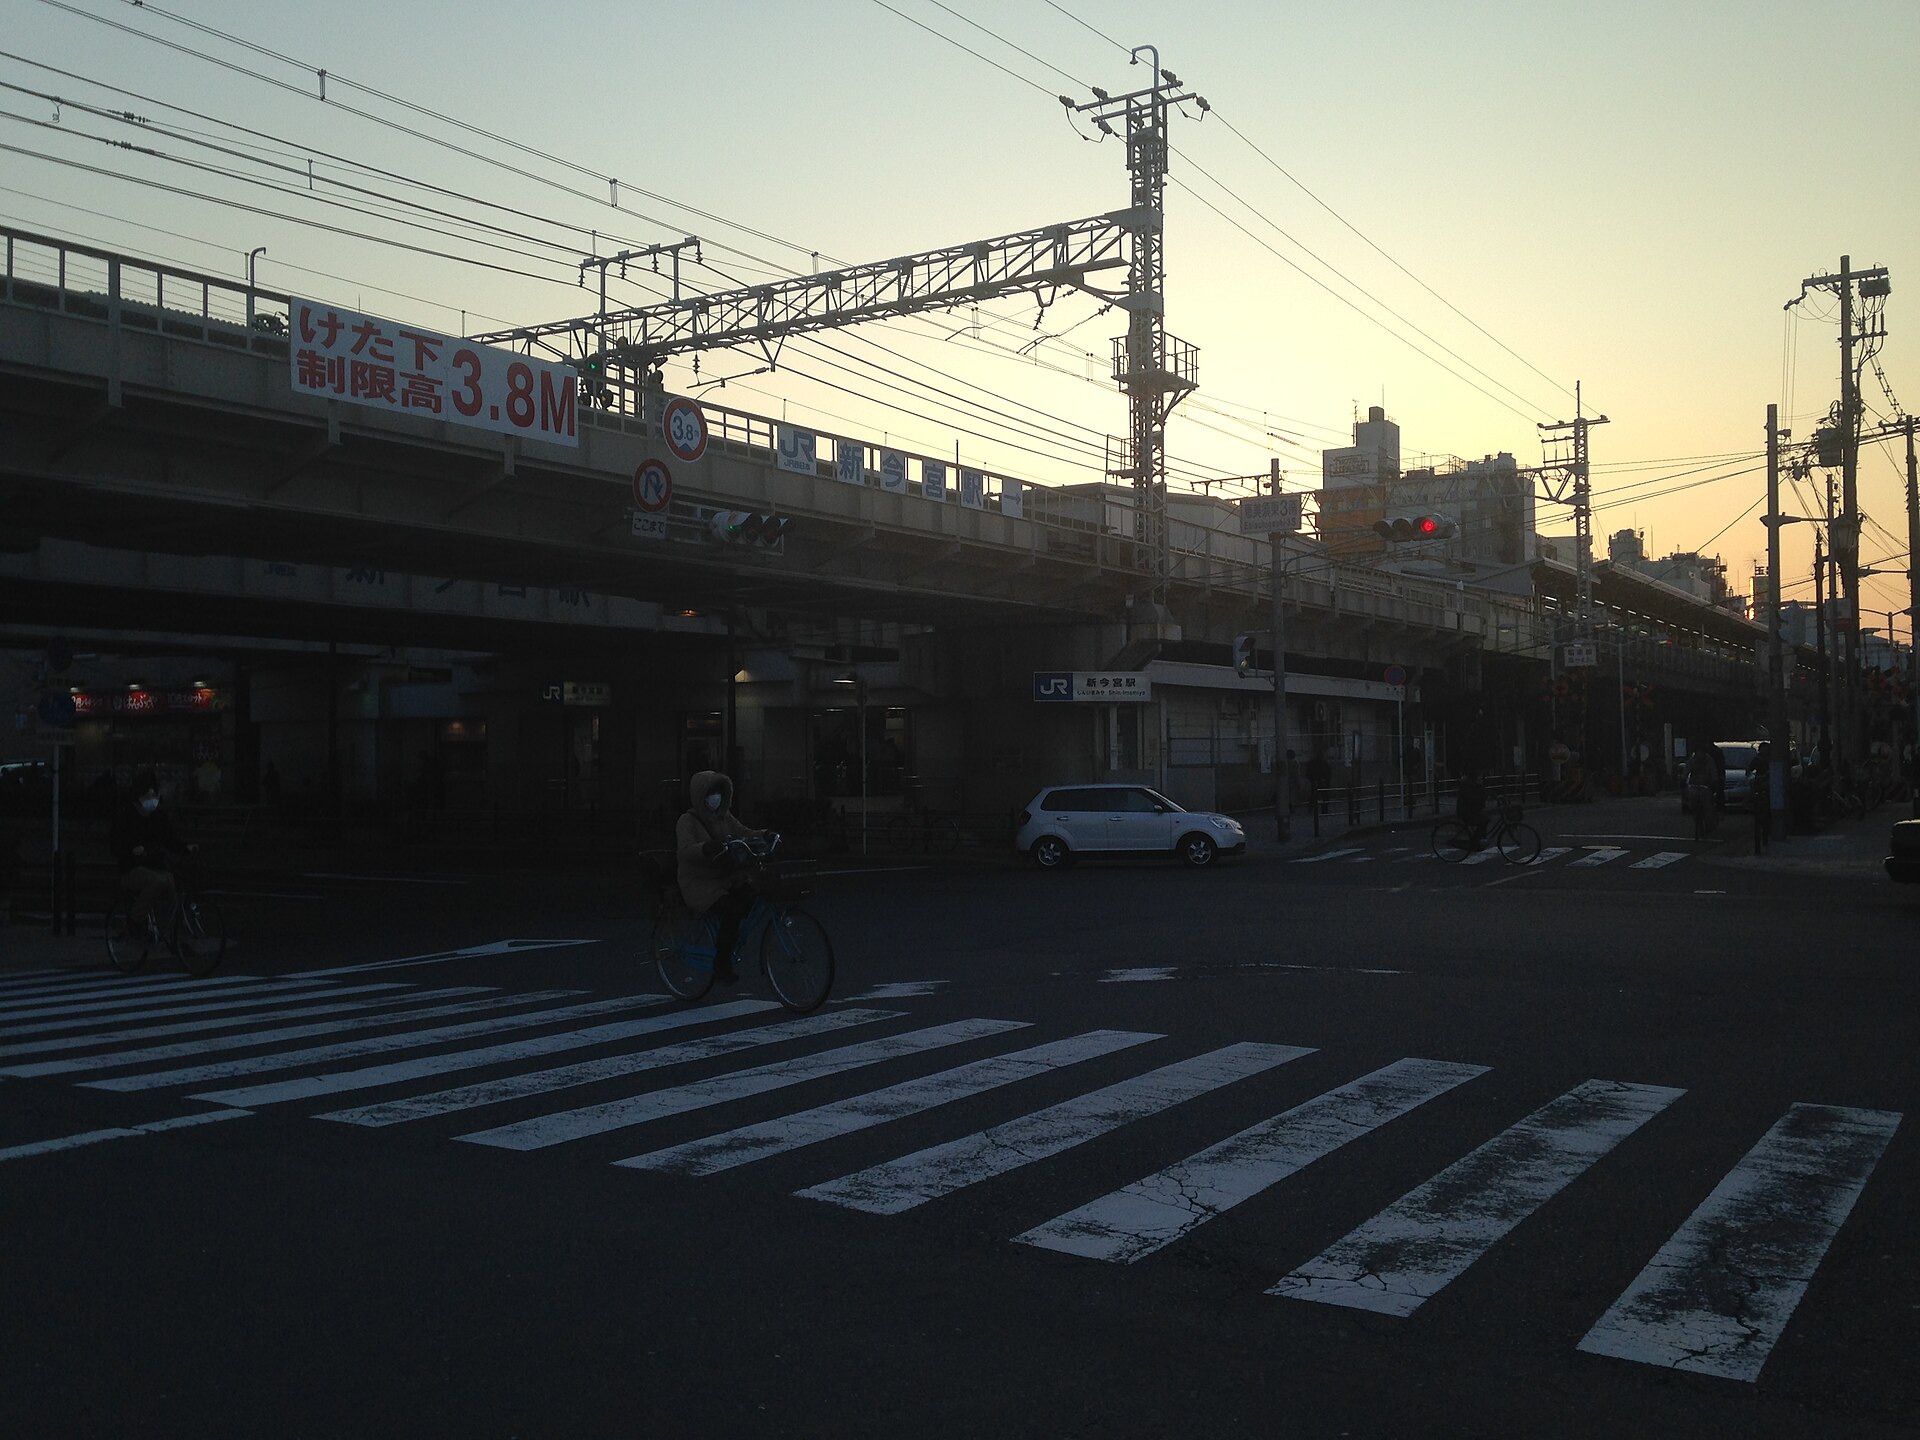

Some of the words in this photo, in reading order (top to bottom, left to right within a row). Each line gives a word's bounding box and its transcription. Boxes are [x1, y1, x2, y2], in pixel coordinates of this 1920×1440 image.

[299, 305, 444, 371] けた下
[296, 349, 444, 414] 制限高
[451, 348, 575, 437] 3.8M
[780, 430, 814, 463] JR
[838, 441, 982, 507] 新今宮駅
[634, 518, 665, 534] ここまで
[543, 685, 560, 700] JR
[1040, 678, 1068, 695] JR
[1086, 677, 1136, 688] 新今宮駅
